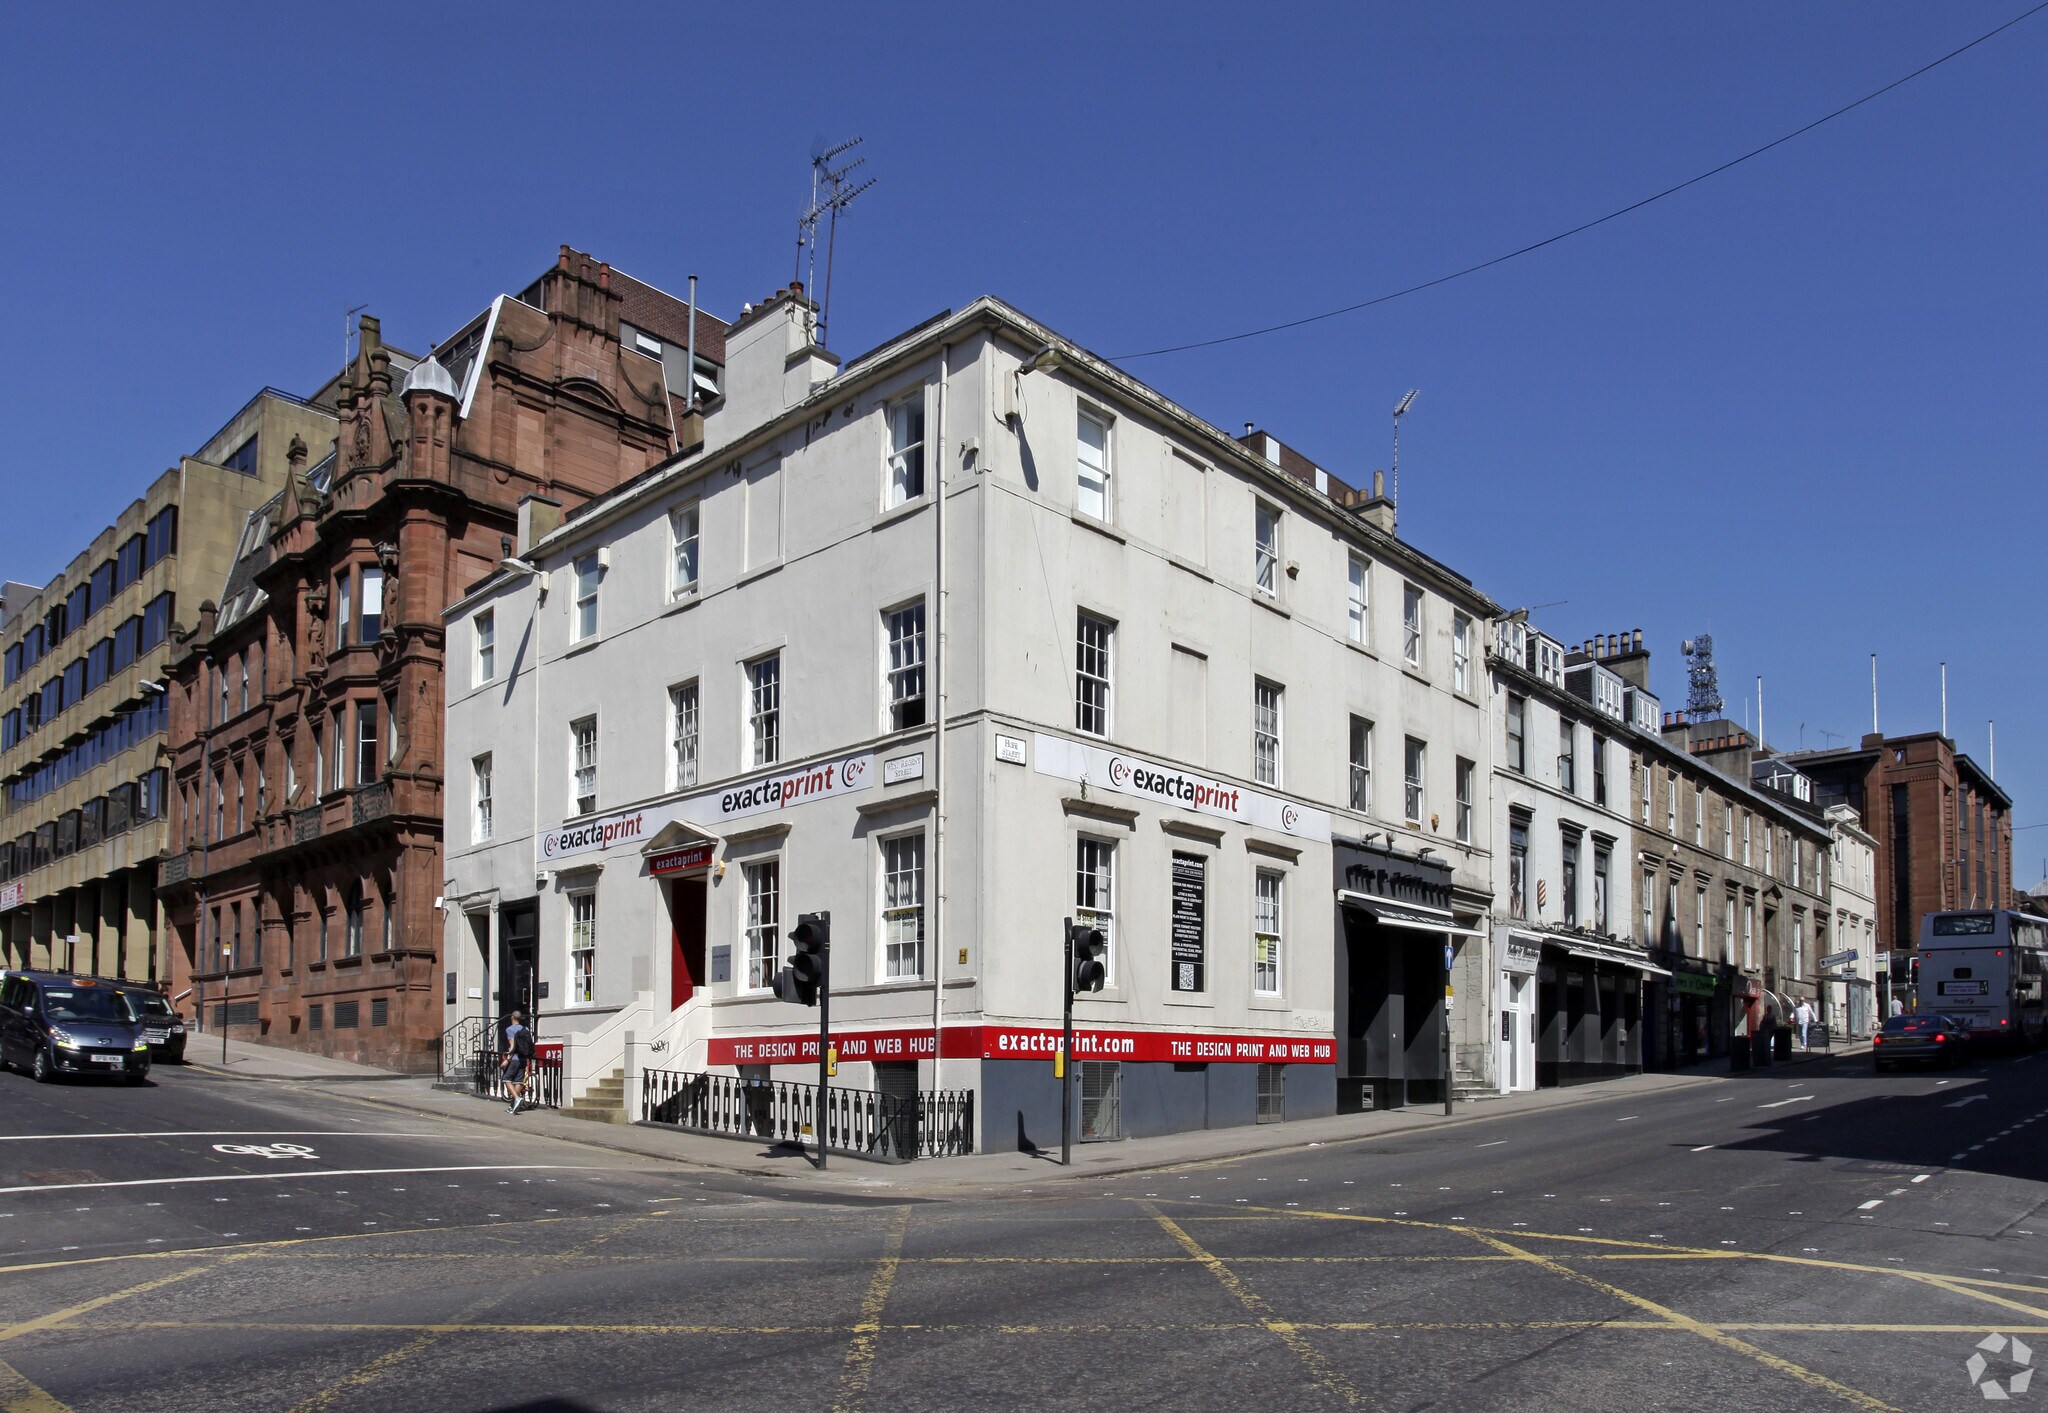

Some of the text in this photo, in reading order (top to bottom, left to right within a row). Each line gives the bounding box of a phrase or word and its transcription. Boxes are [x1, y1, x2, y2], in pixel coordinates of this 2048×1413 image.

[722, 764, 834, 813] exactaprint
[1133, 768, 1239, 812] exactaprint
[560, 813, 642, 850] exactaprint
[656, 851, 702, 869] exactaprint
[734, 1037, 935, 1058] THE DESIGN PRIT AND WEB HUB
[999, 1032, 1134, 1053] exactapint.com
[1171, 1041, 1330, 1058] THE DESIGN PRINT AND WEB HUB
